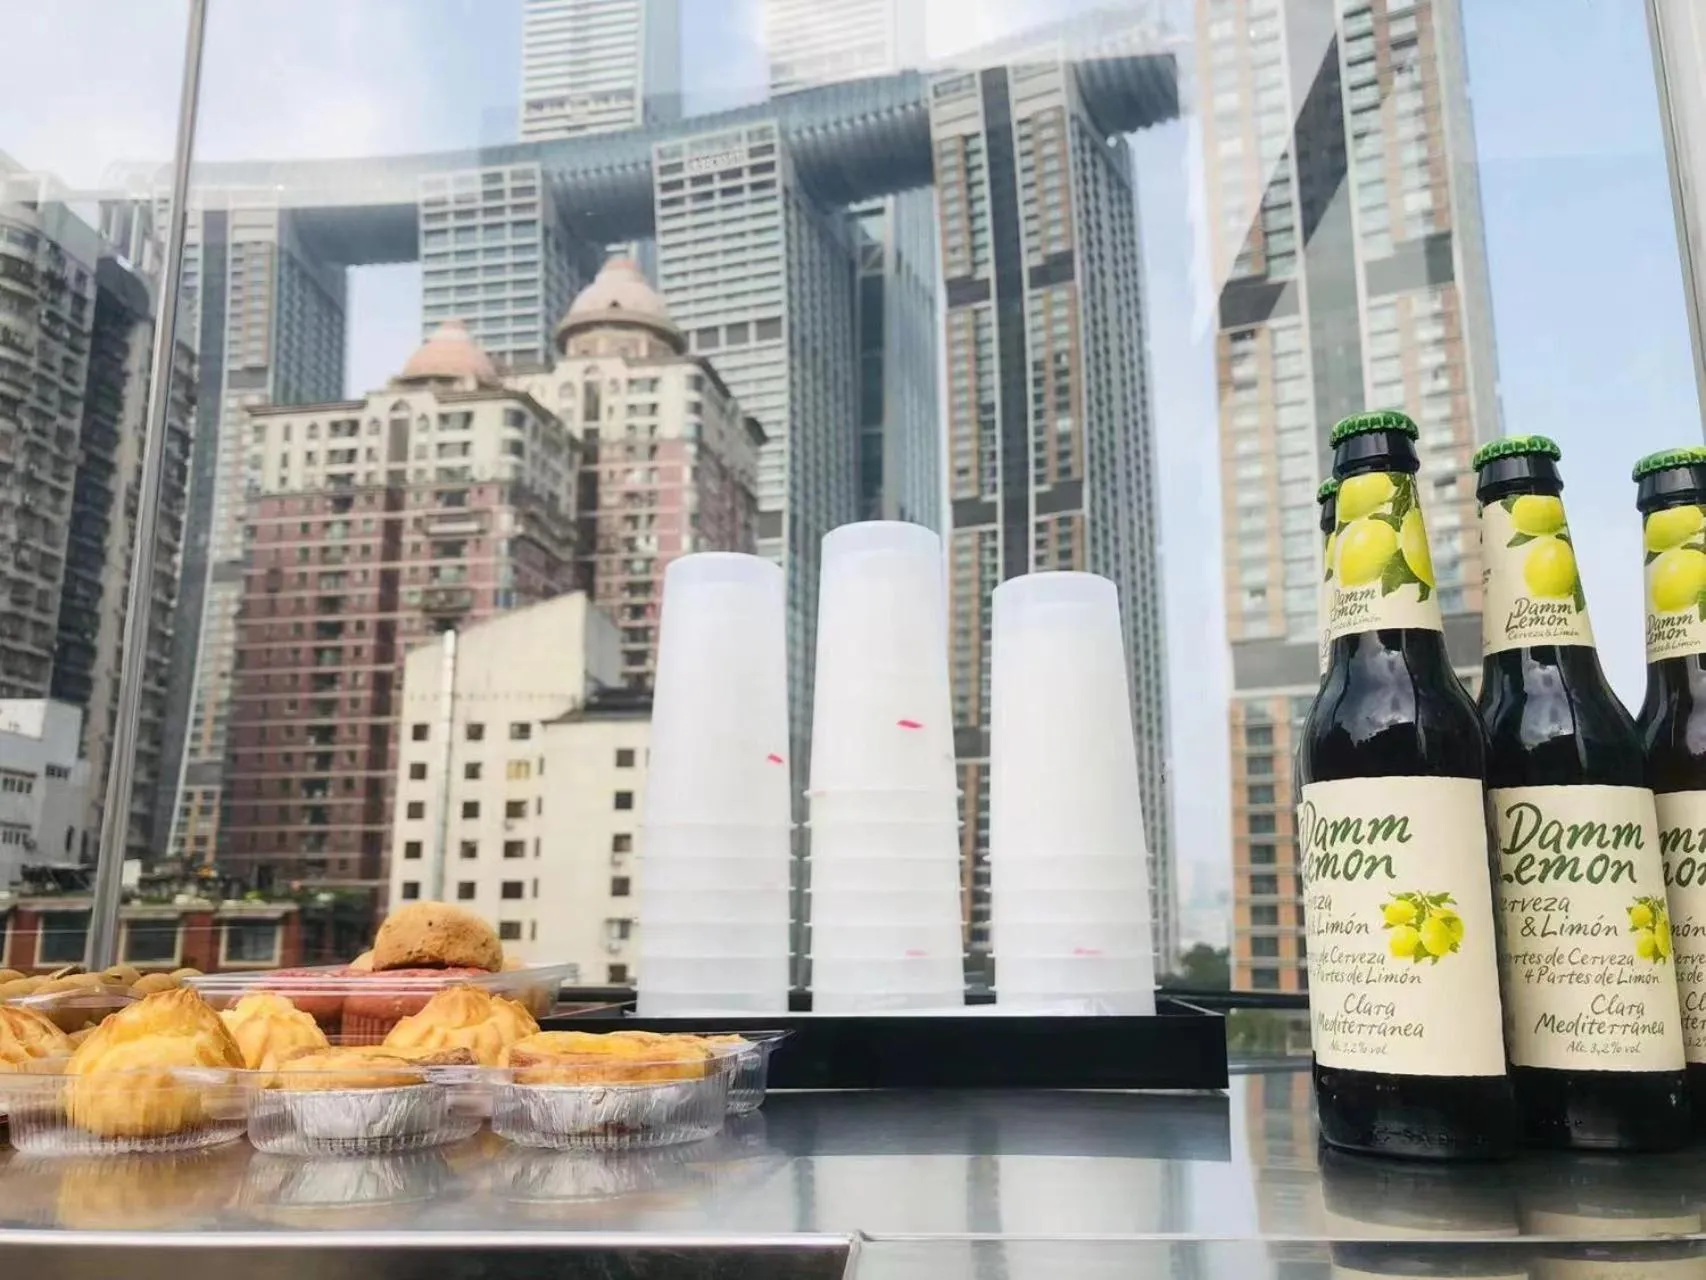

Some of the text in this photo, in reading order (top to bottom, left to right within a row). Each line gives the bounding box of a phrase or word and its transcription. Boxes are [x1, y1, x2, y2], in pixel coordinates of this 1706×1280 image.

[1514, 597, 1572, 619] Damm
[1505, 611, 1569, 633] Lemon
[1647, 614, 1693, 635] Damm
[1300, 800, 1412, 857] Damm
[1502, 802, 1645, 855] Damm
[1502, 853, 1637, 885] emon
[1501, 897, 1570, 912] erveza
[1331, 946, 1385, 965] Cerveza
[1508, 951, 1542, 965] rtes
[1568, 946, 1634, 966] Cerveza
[1366, 966, 1424, 985] Limón
[1525, 968, 1535, 984] 4
[1537, 965, 1592, 985] Partes
[1616, 967, 1661, 985] Limón
[1344, 993, 1396, 1016] Clara
[1591, 993, 1644, 1016] Clara
